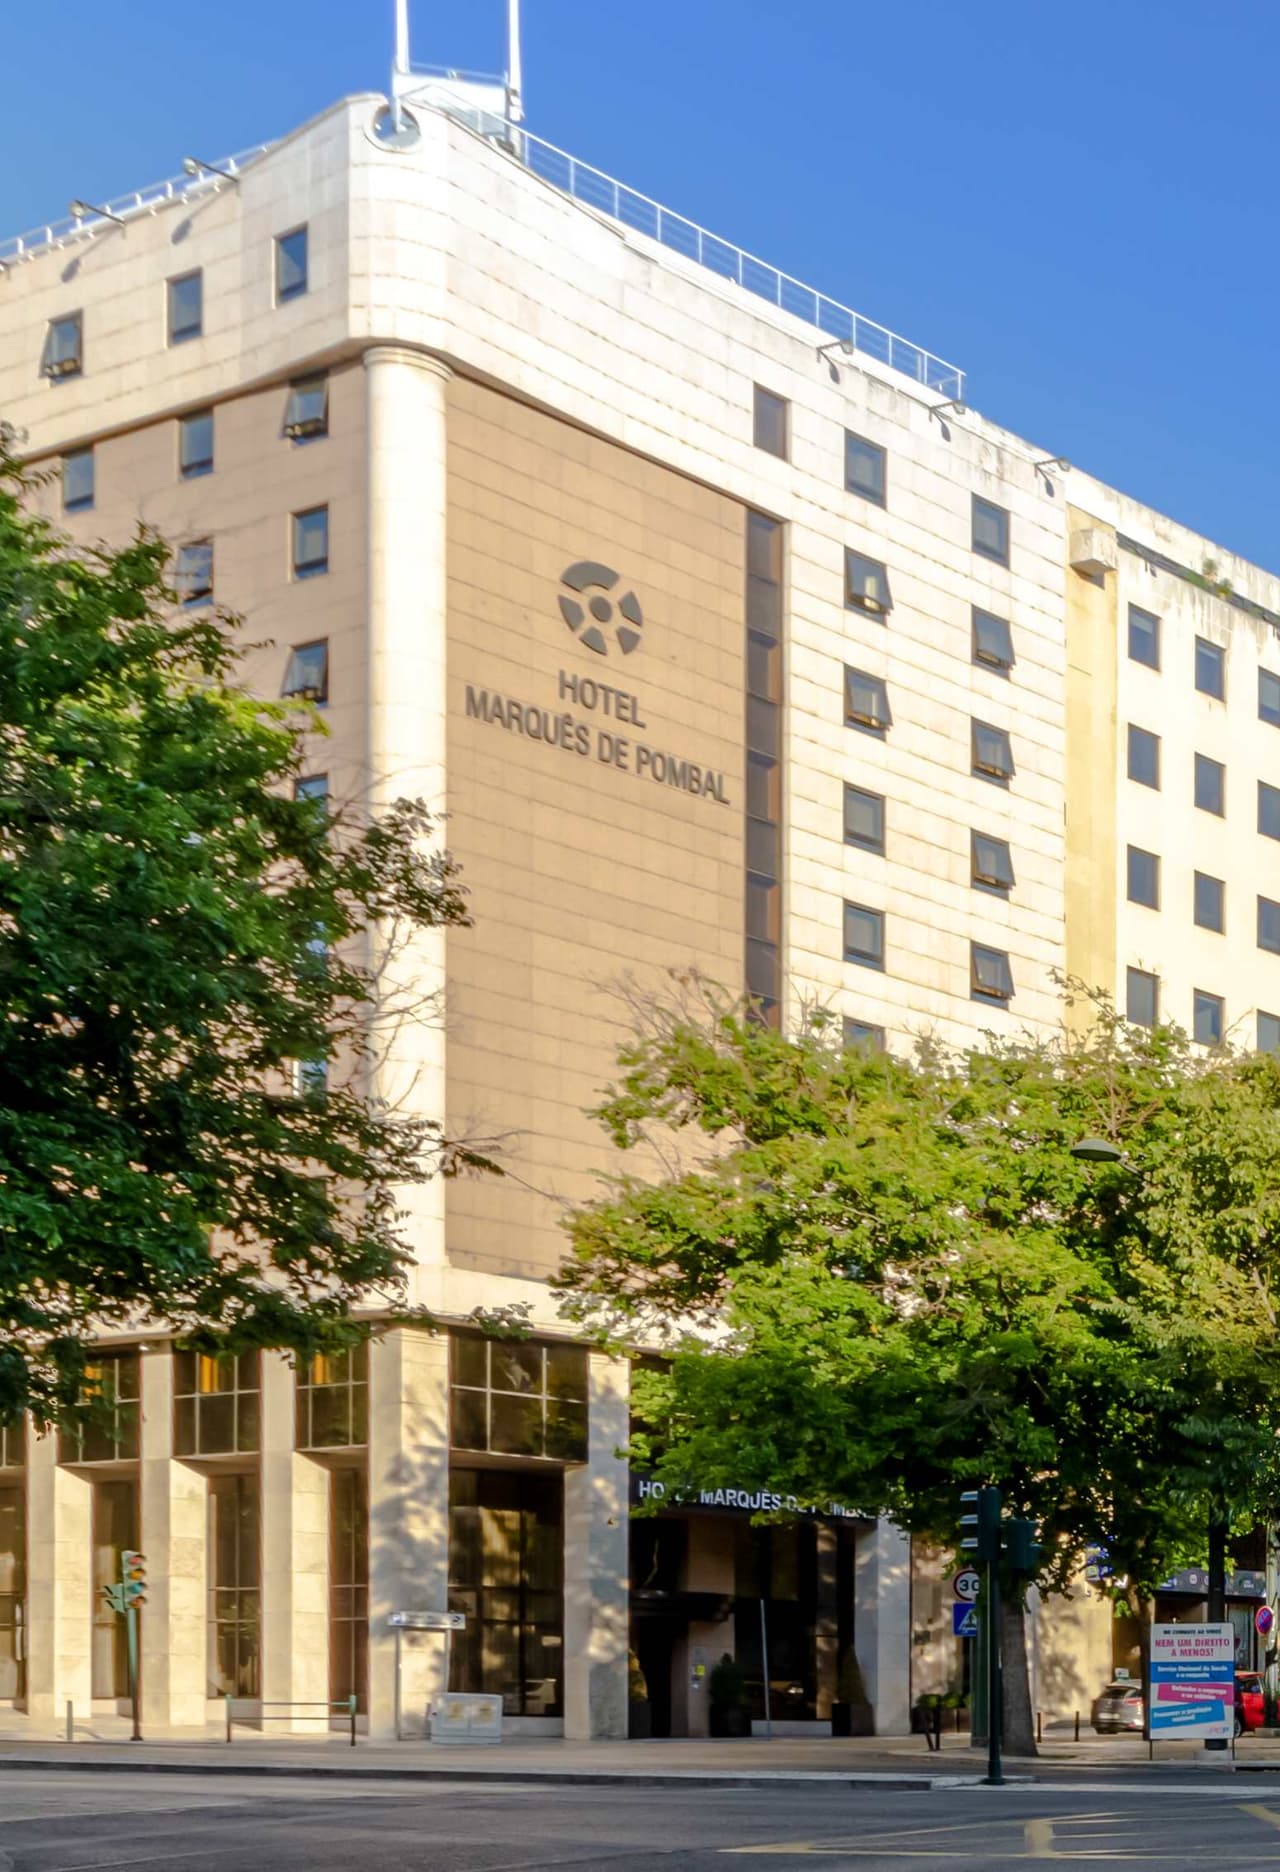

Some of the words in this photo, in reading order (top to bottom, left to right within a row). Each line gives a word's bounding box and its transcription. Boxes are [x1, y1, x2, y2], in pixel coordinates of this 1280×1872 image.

[558, 669, 646, 729] HOTEL
[465, 685, 590, 756] MARQUÊS
[598, 730, 628, 770] DE
[636, 745, 730, 805] POMBAL
[960, 1579, 979, 1592] 30
[1155, 1639, 1174, 1647] NEM
[1195, 1638, 1229, 1647] DIREITO
[1180, 1649, 1214, 1657] MENOS!
